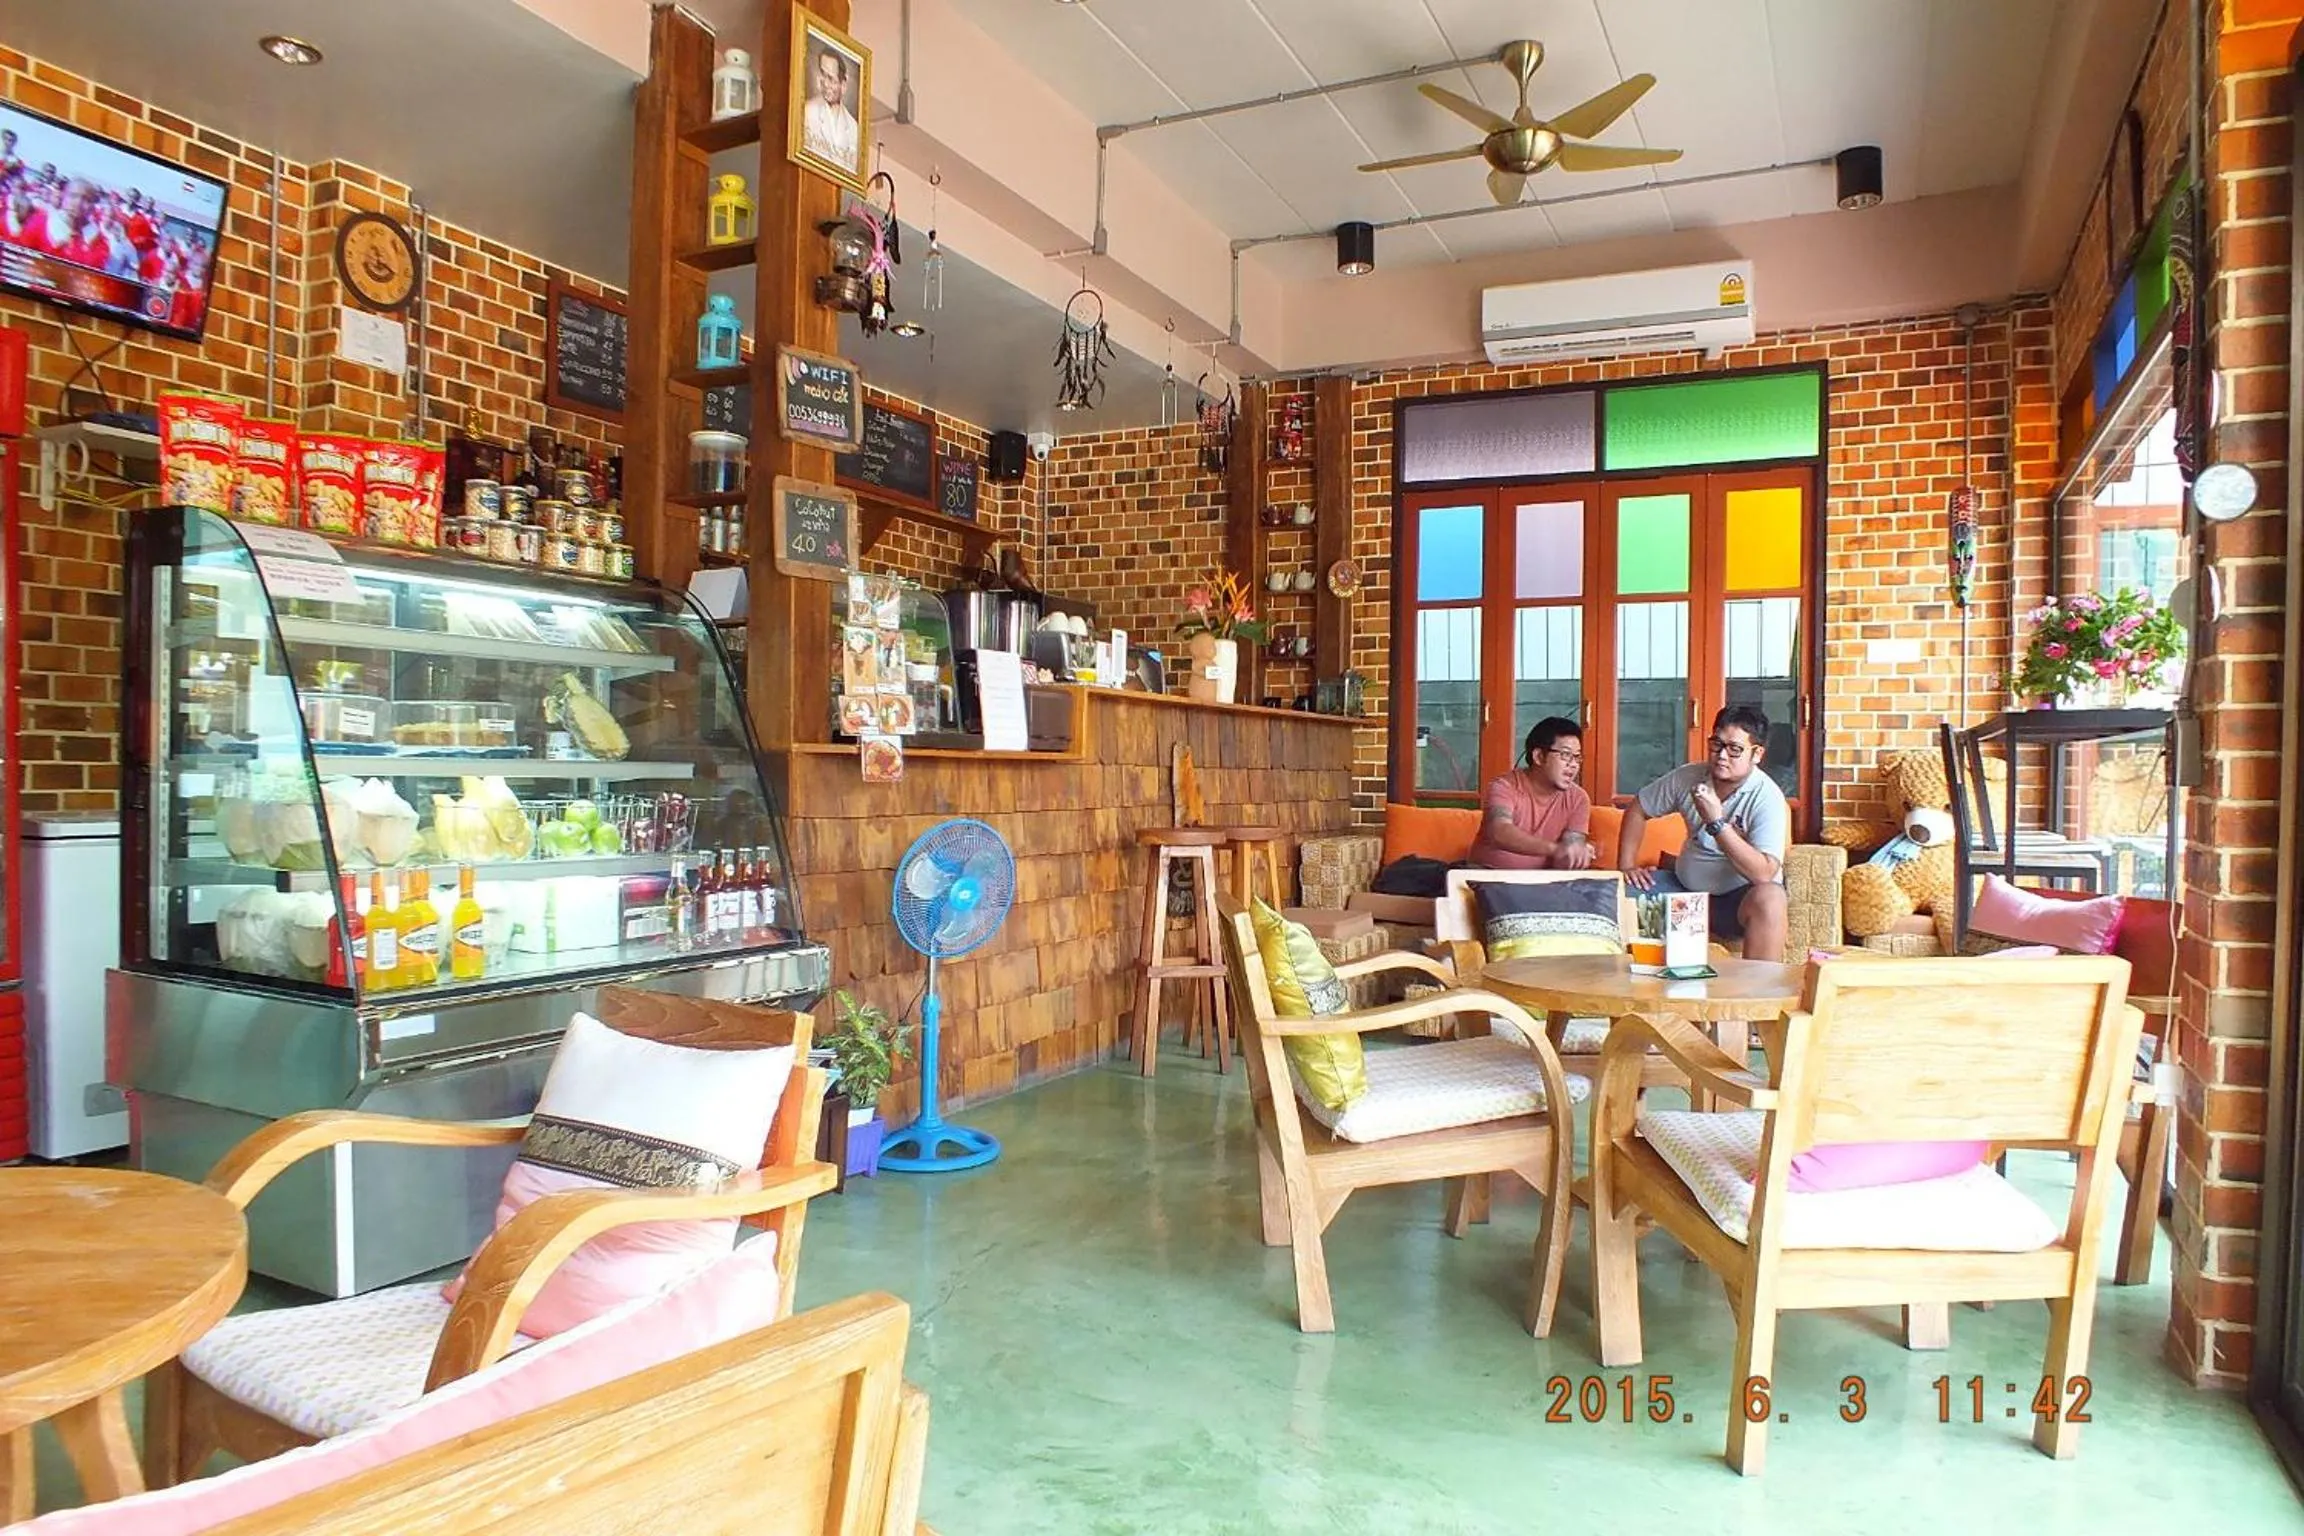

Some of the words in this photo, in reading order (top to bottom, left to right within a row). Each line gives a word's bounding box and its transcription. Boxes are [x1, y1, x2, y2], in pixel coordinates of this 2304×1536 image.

[810, 366, 848, 385] WIFI
[942, 461, 973, 477] WINE
[945, 483, 967, 508] 80
[791, 533, 817, 554] 40
